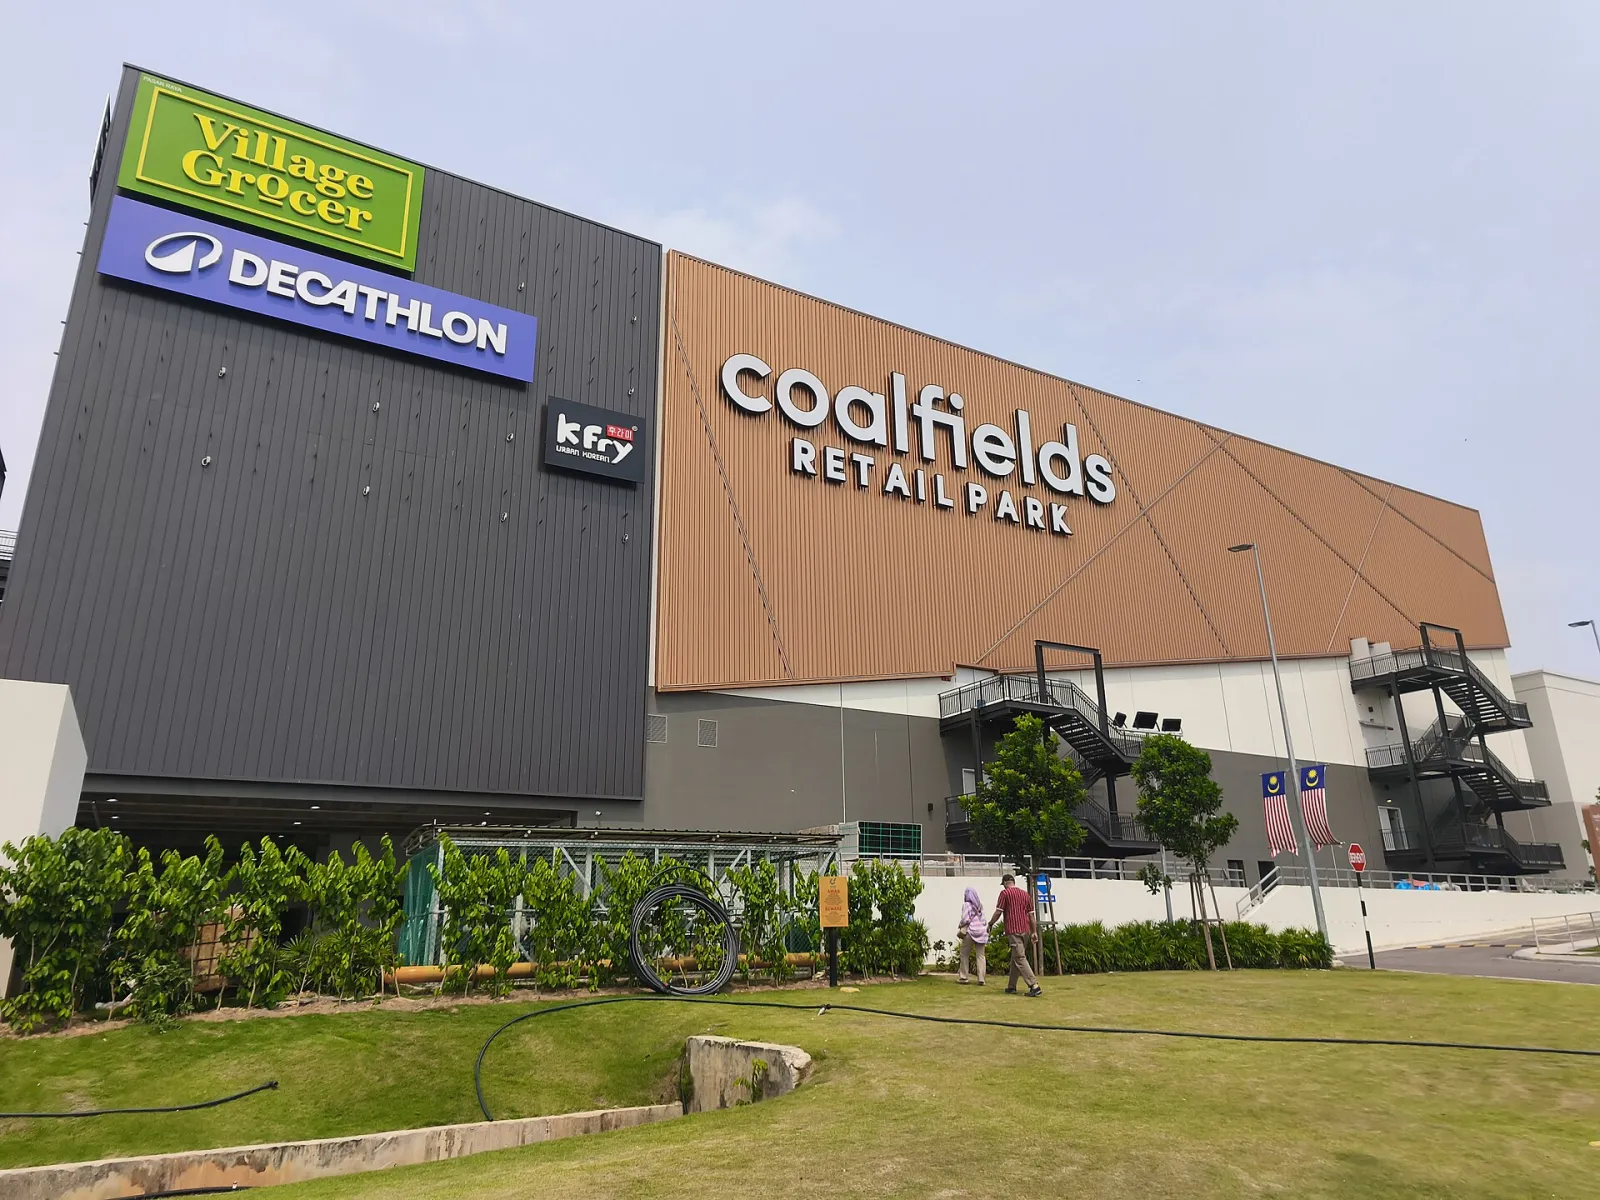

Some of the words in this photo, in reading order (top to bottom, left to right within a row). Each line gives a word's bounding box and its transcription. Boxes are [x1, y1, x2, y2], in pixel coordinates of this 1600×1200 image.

[143, 75, 165, 88] PASAR
[182, 150, 373, 232] Grocer
[193, 112, 374, 199] Village
[228, 249, 508, 355] DECATHLON
[556, 445, 579, 456] URBAN
[582, 451, 610, 463] KOREAN
[557, 413, 633, 464] kfry
[721, 352, 1117, 504] coalfields
[791, 437, 954, 508] RETAIL
[967, 481, 1073, 535] PARK
